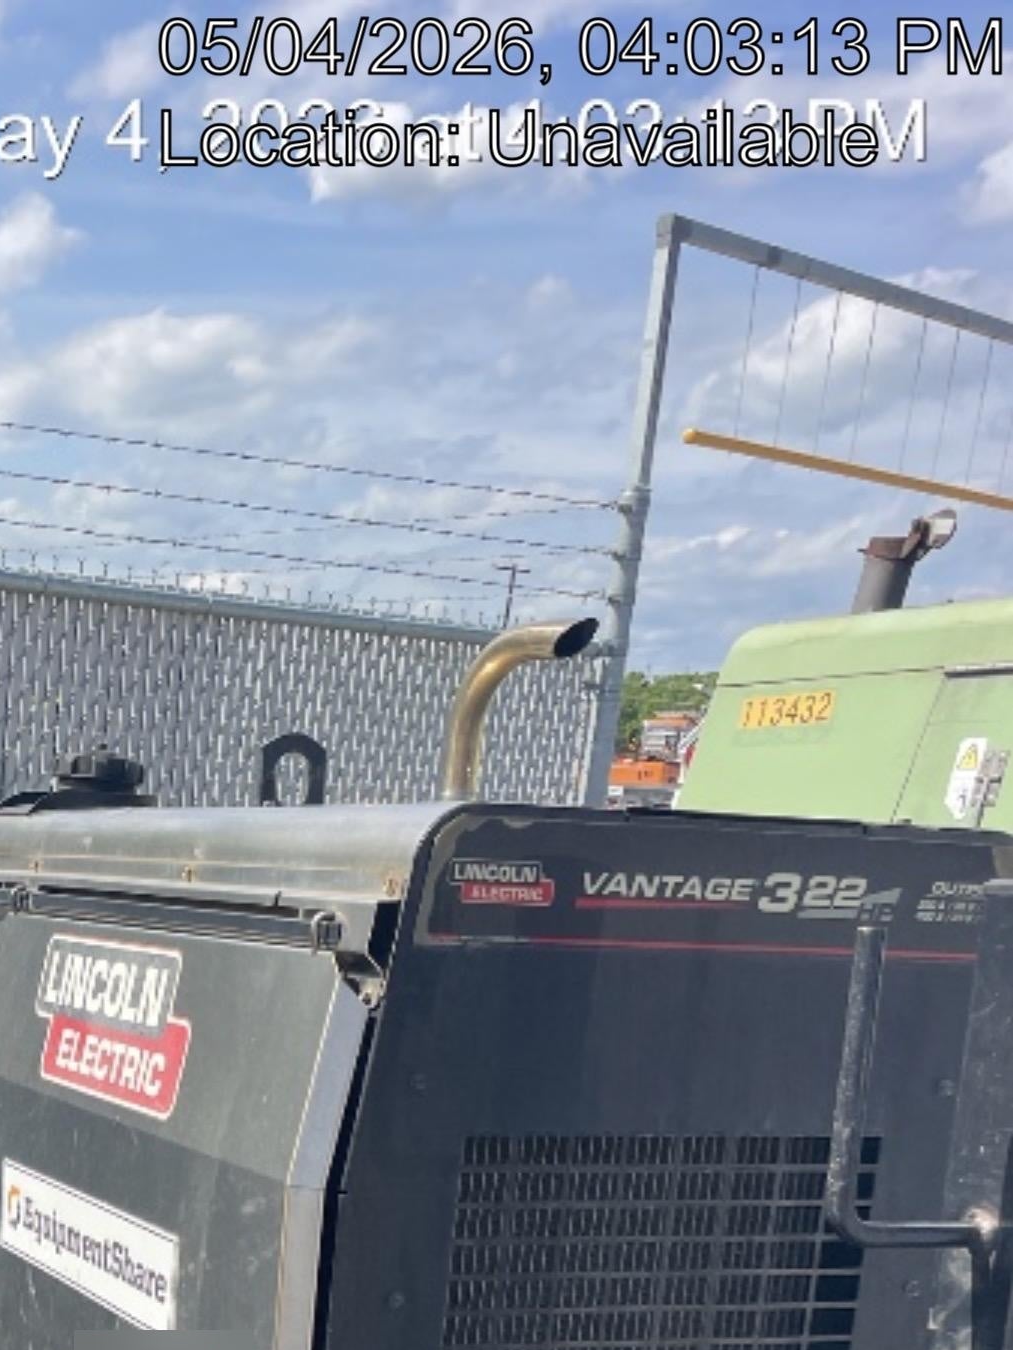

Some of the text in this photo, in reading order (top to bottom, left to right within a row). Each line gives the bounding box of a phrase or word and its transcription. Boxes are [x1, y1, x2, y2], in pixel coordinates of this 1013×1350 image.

[742, 691, 832, 728] 113432
[453, 863, 538, 883] LINCOLN
[471, 886, 544, 901] ELECTRIC
[583, 872, 757, 902] VANTAGE
[757, 872, 868, 913] 322
[44, 949, 170, 1027] LINCOLN
[55, 1028, 167, 1098] ELECTRIC
[22, 1196, 169, 1305] EquipmentShare
